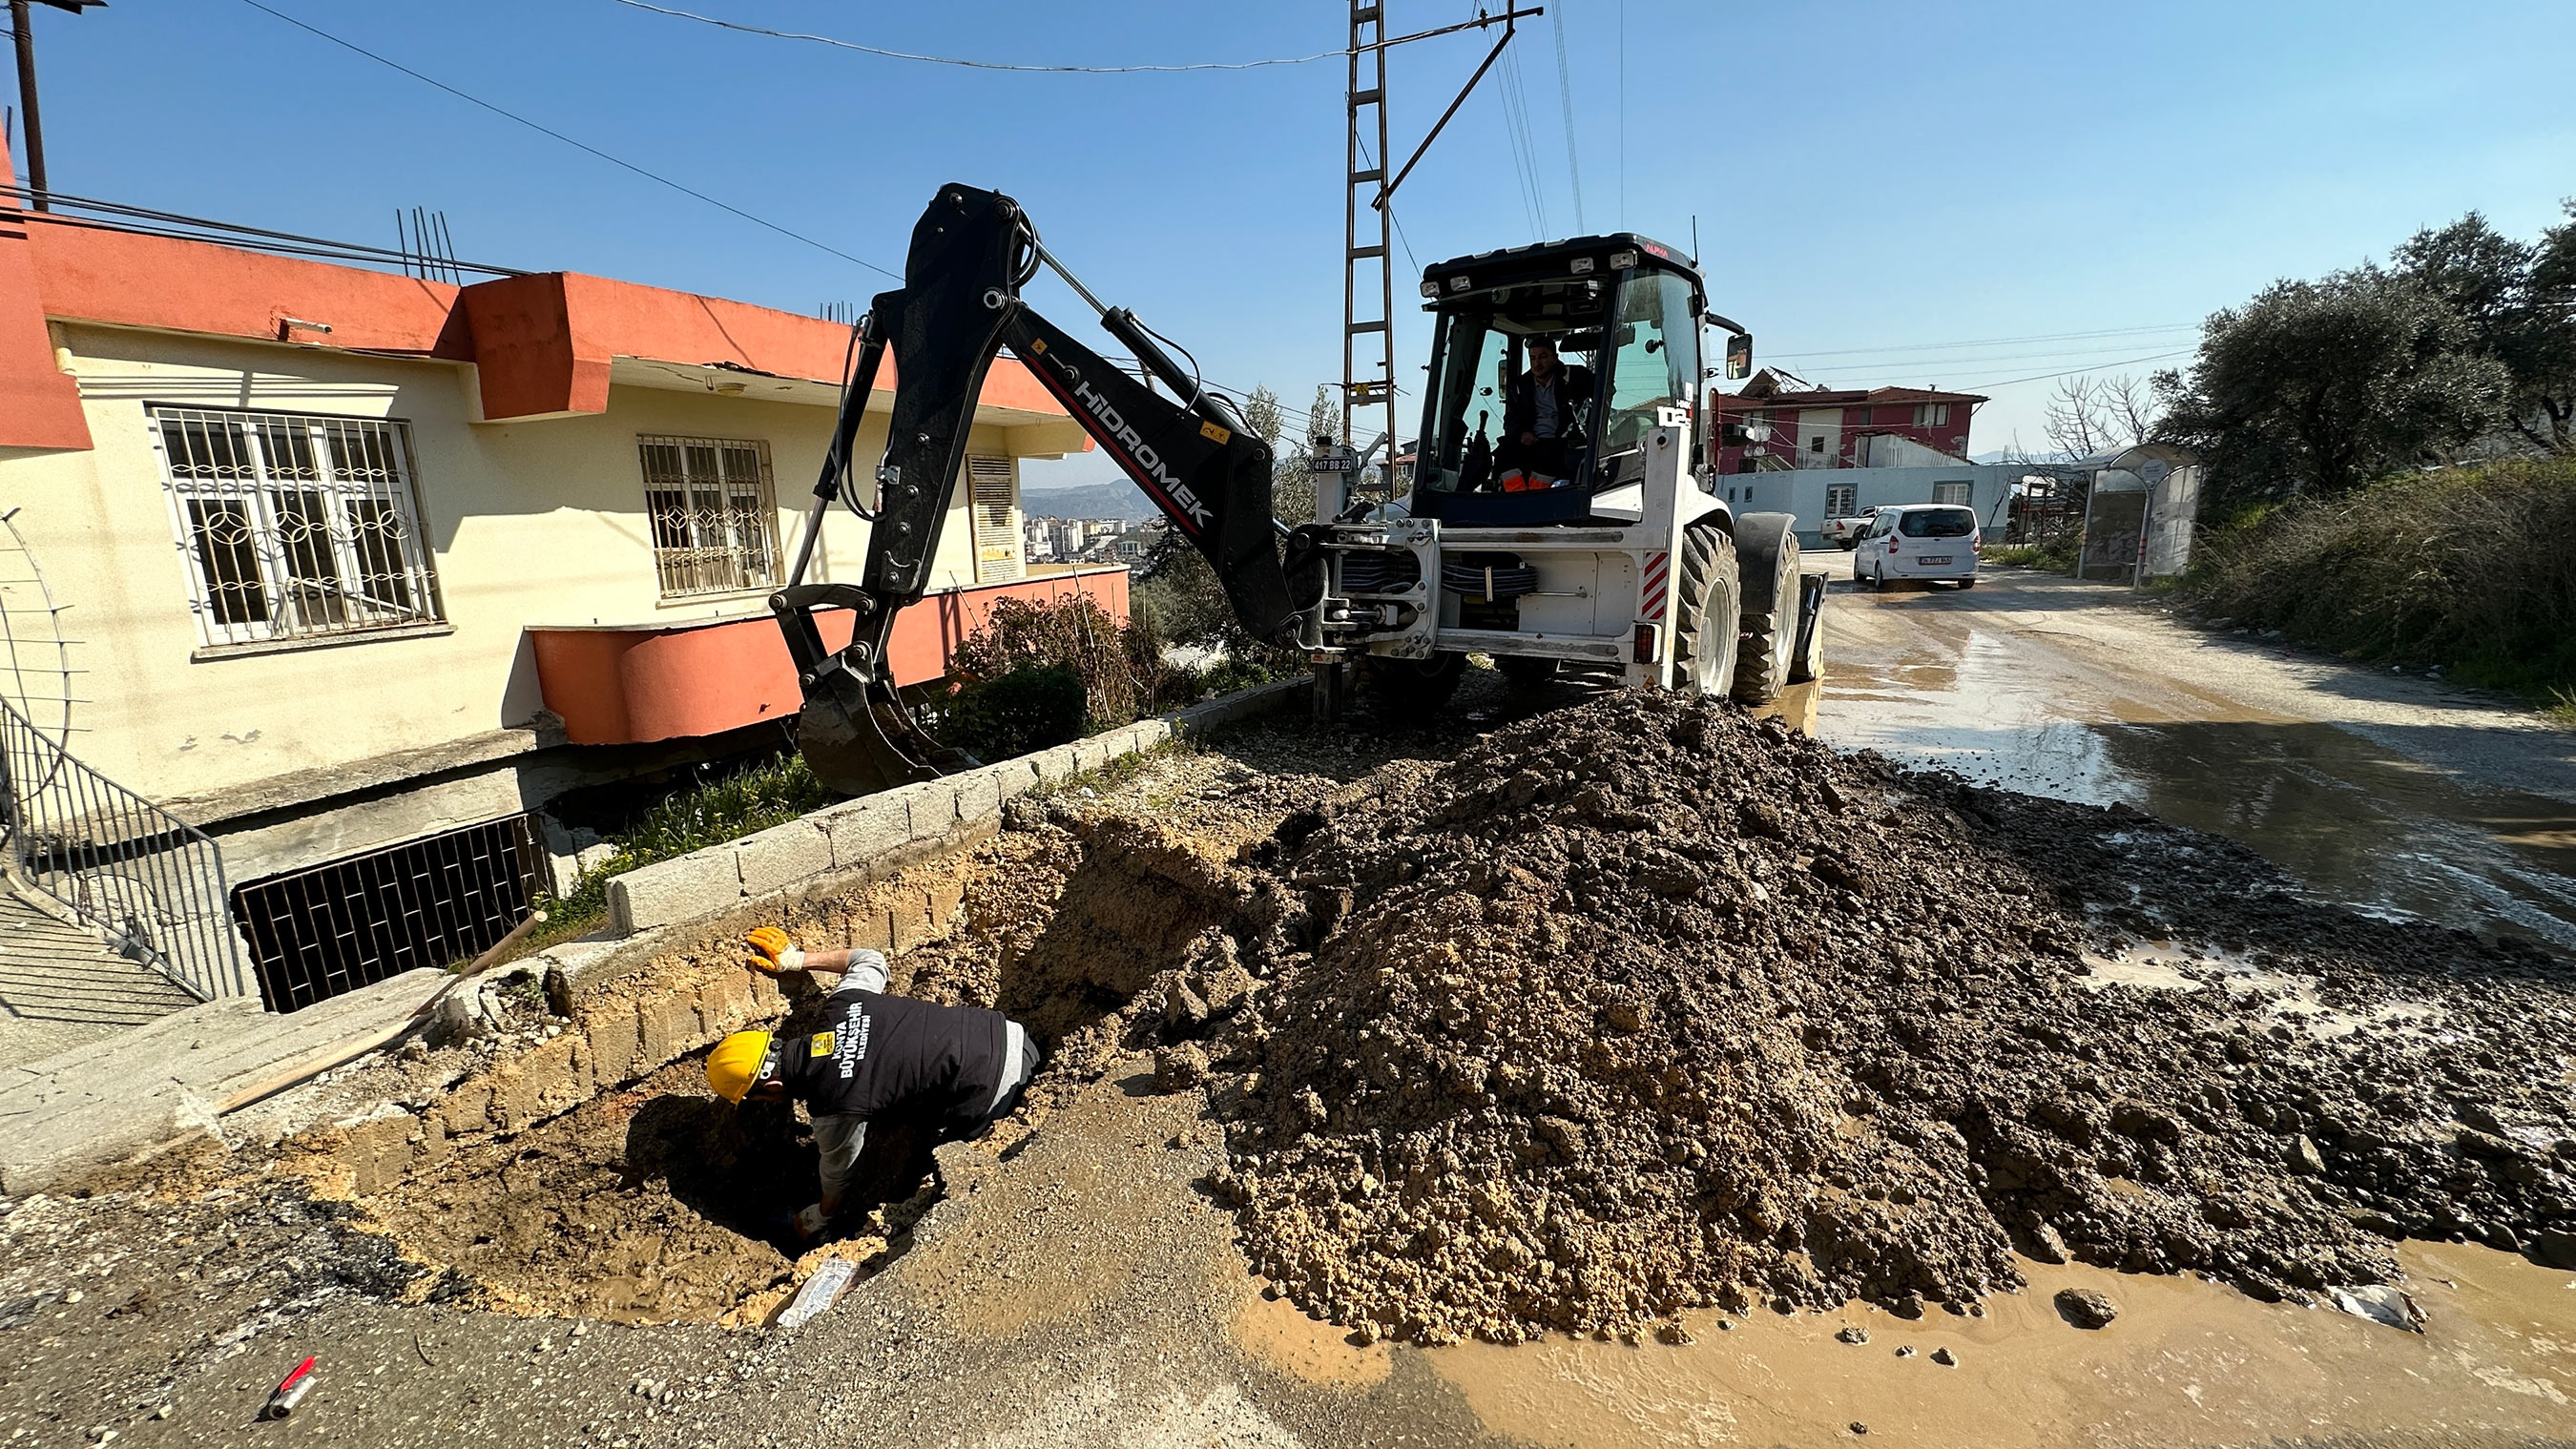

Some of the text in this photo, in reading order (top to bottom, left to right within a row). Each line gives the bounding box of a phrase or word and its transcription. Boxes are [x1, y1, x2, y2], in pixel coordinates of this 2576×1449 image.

[1074, 381, 1214, 528] HİDROMEK
[1314, 460, 1351, 470] 417 BB 22
[831, 1021, 847, 1060] KONYA
[839, 1002, 863, 1079] BÜYÜKŞEHİR
